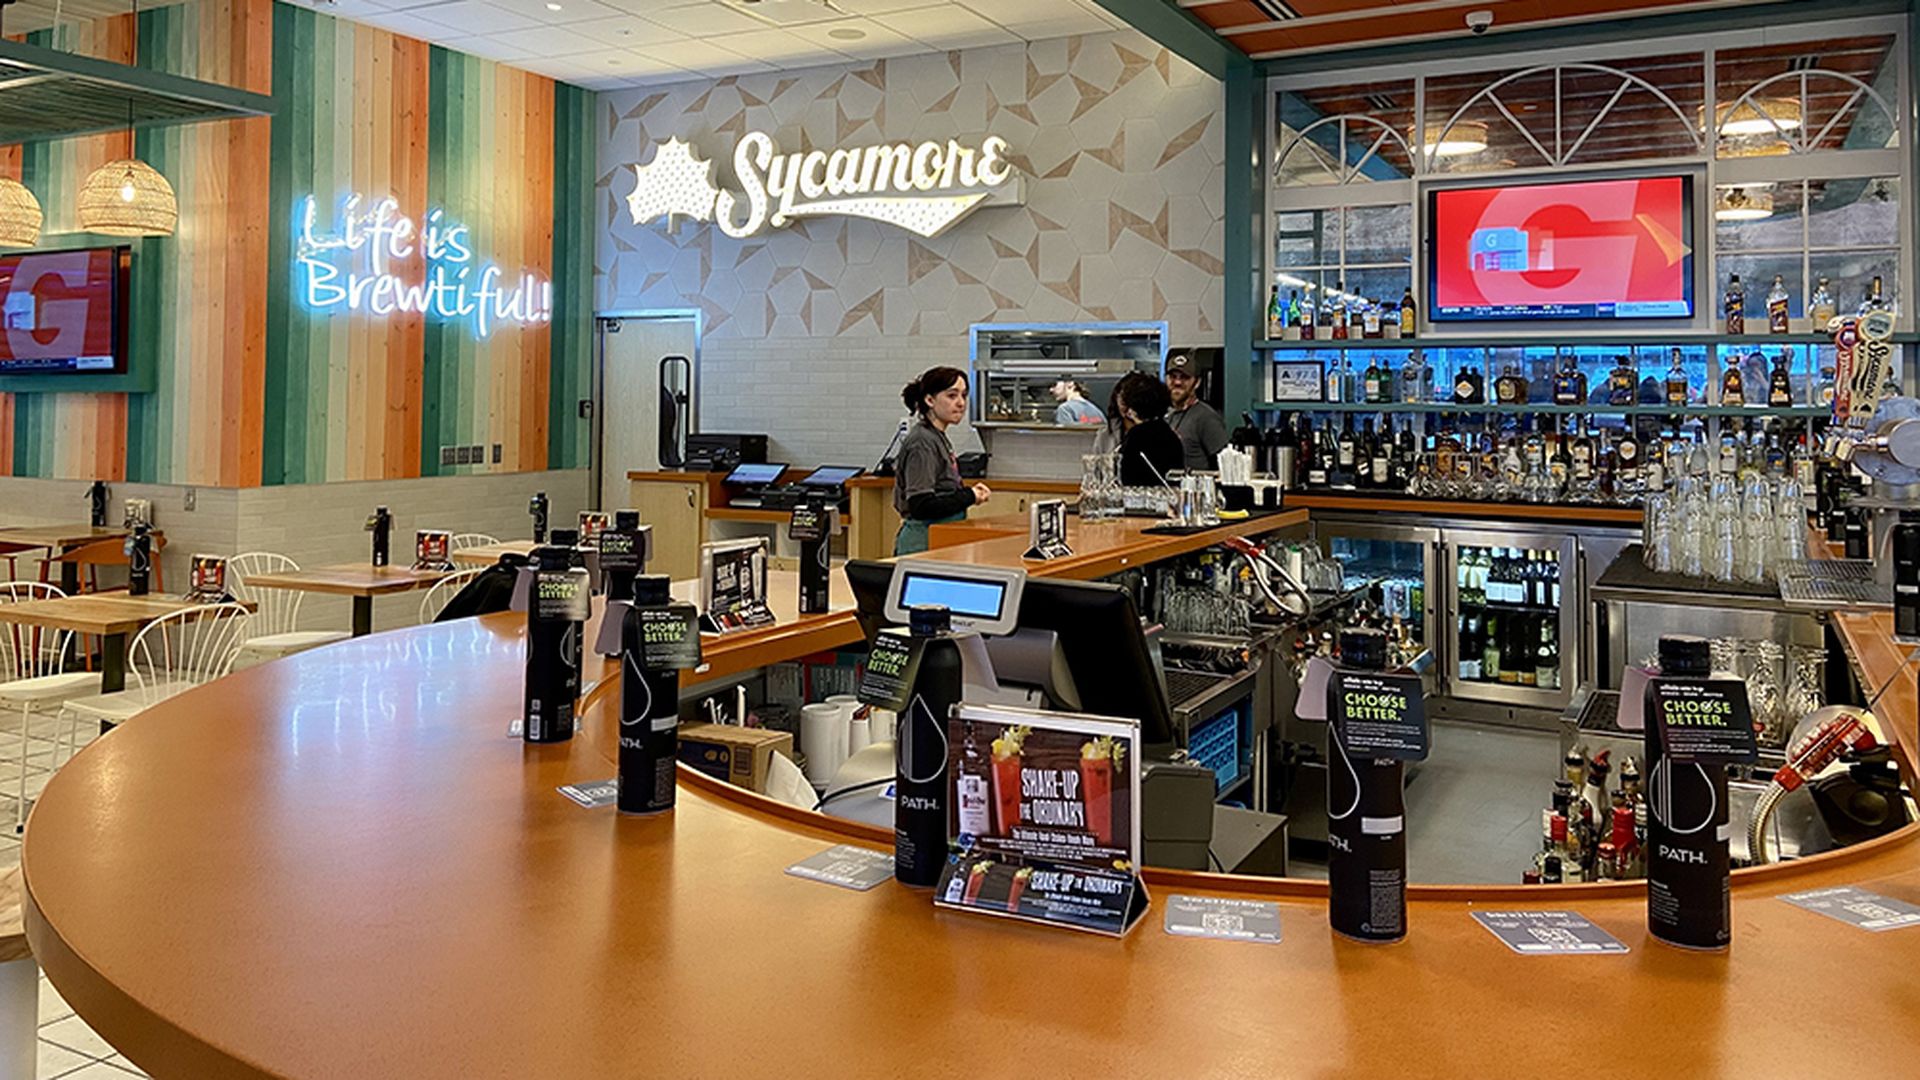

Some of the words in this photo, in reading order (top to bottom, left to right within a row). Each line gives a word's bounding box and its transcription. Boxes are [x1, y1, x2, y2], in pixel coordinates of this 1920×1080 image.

[715, 131, 1011, 238] Sycamore
[303, 194, 414, 276] Life
[427, 209, 472, 263] is
[299, 259, 551, 337] Brewtiful!
[1345, 692, 1407, 710] CHOOSE
[1663, 699, 1732, 714] CHOOSE
[1346, 706, 1402, 721] BETTER.
[1665, 713, 1727, 727] BETTER.
[1021, 768, 1079, 800] SHAKE-UP
[901, 795, 940, 810] PATH.
[1032, 799, 1085, 827] ORDINARY
[1659, 844, 1708, 865] PATH.
